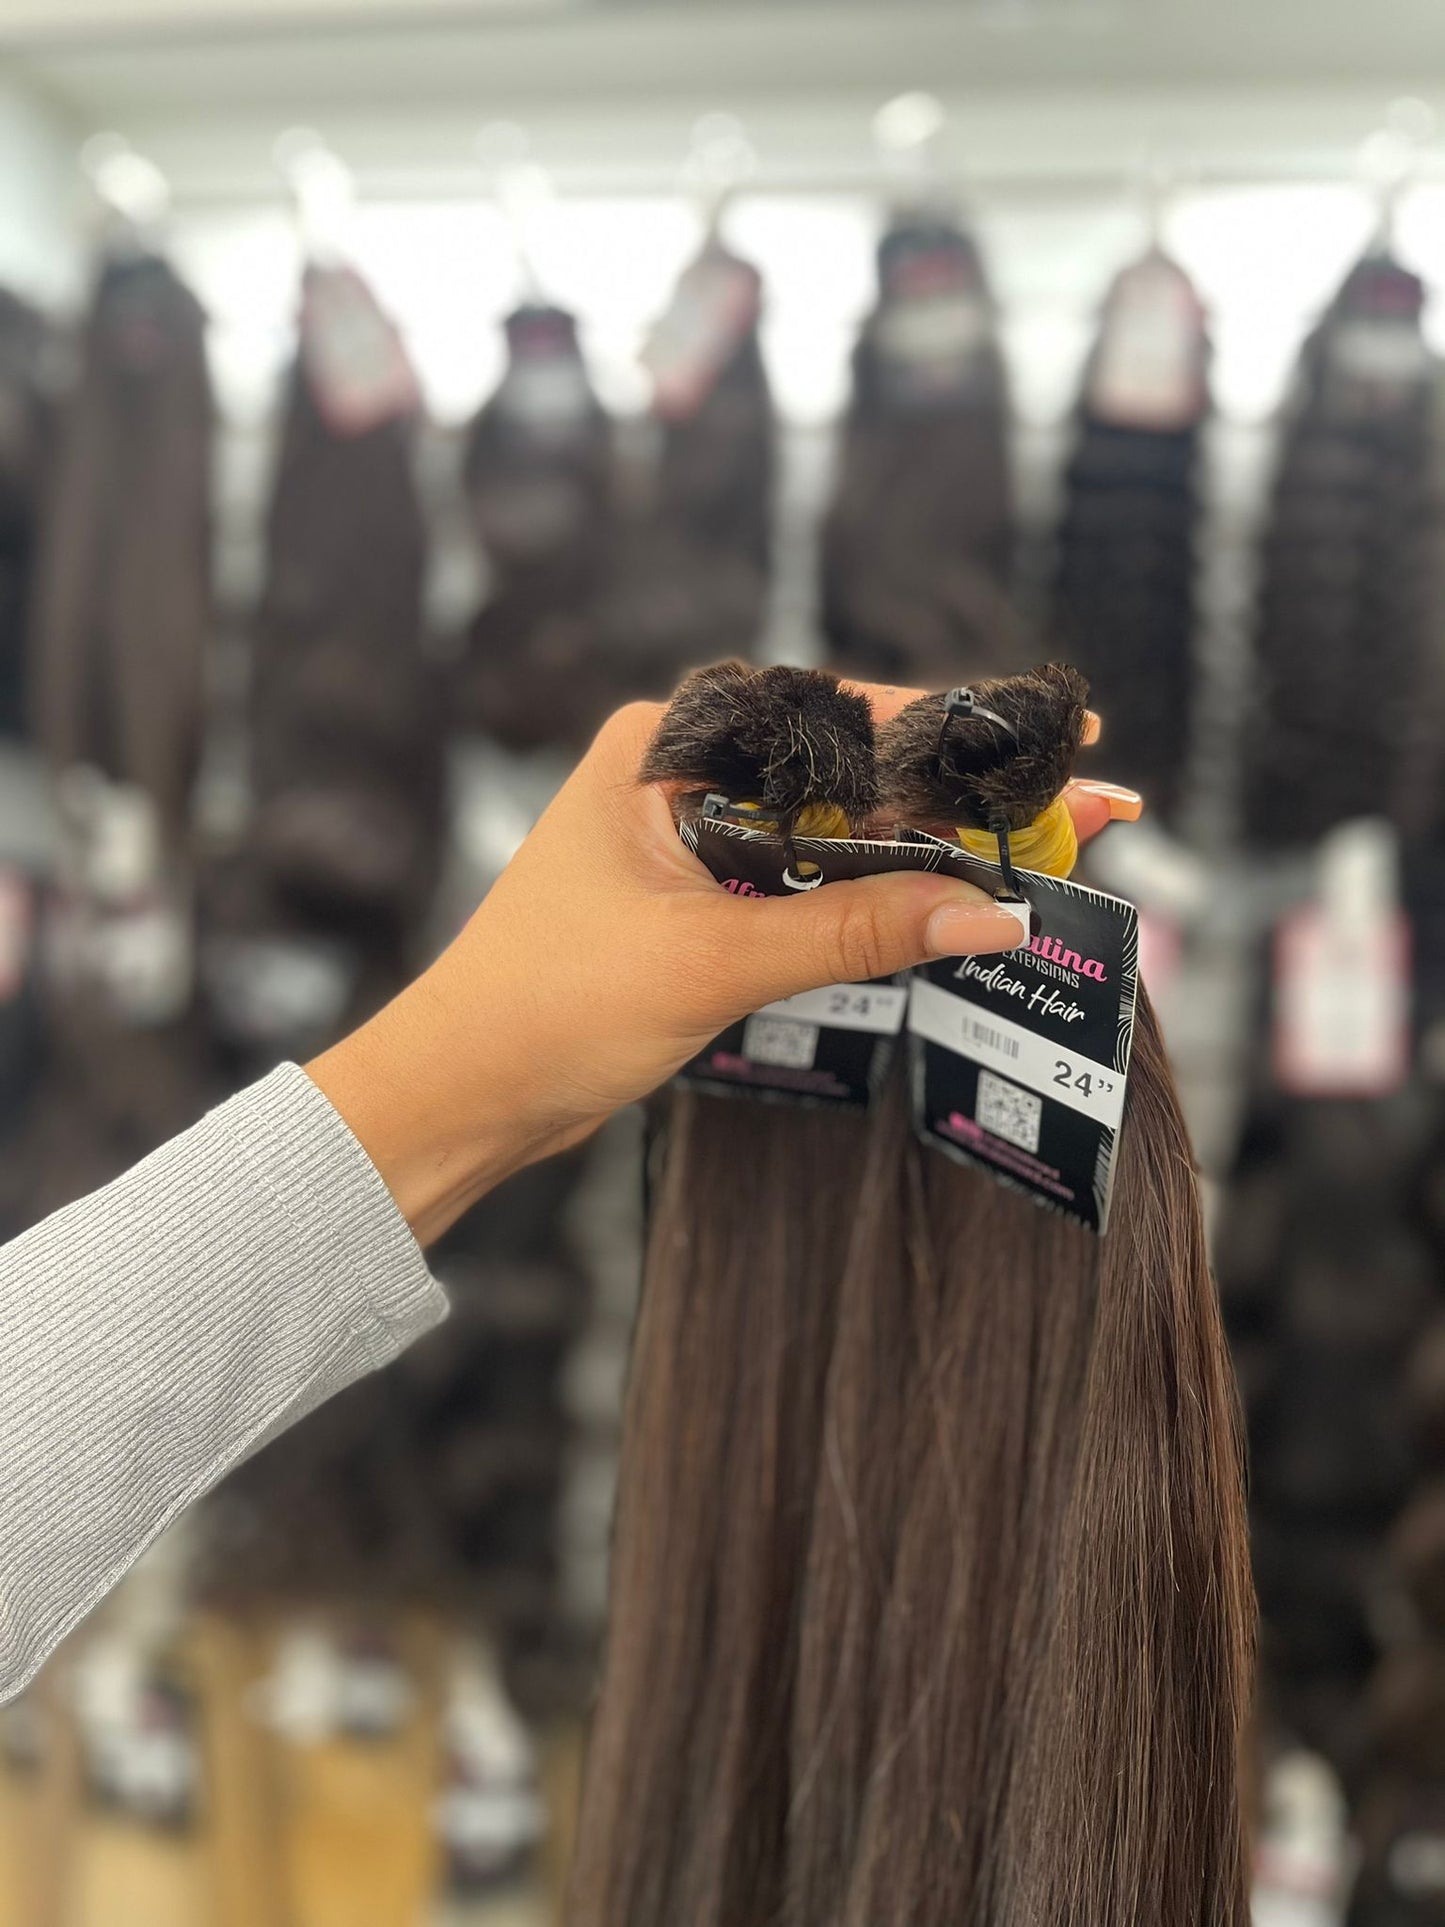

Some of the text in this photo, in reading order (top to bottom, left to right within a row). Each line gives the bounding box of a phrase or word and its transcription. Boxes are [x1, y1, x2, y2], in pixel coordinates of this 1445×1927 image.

[1025, 934, 1108, 982] atina
[953, 954, 1085, 1023] Indian Hair
